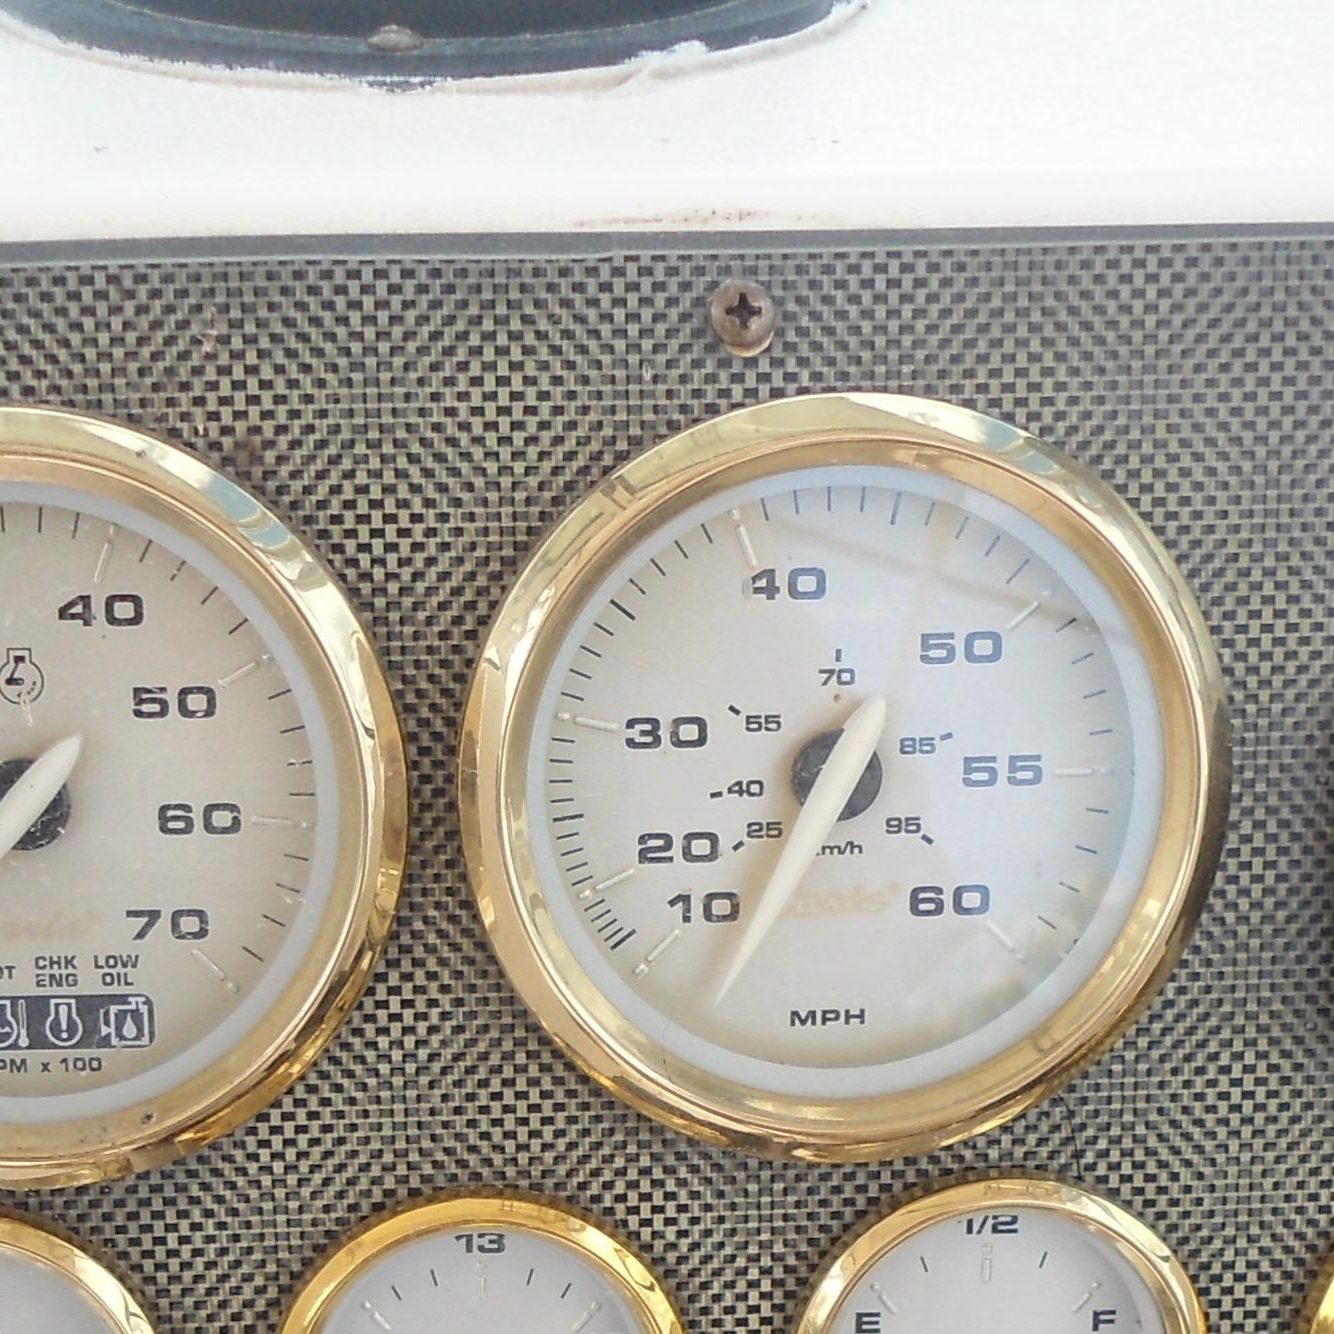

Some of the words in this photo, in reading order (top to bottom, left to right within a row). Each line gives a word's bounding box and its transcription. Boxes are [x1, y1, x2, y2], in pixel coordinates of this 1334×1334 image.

[743, 567, 827, 600] 40
[58, 593, 144, 627] 40
[919, 632, 1003, 665] 50
[819, 668, 856, 687] 70
[132, 685, 217, 720] 50
[624, 716, 708, 750] 30
[744, 714, 782, 733] 55
[899, 737, 937, 756] 85
[961, 754, 1043, 788] 55
[726, 779, 764, 798] 40
[157, 802, 242, 836] 60
[885, 816, 922, 835] 95
[745, 821, 783, 840] 25
[637, 830, 720, 865] 20
[814, 840, 864, 857] m/h
[667, 891, 740, 924] 10
[909, 884, 991, 917] 60
[125, 908, 210, 942] 70
[34, 955, 78, 970] CHK
[94, 954, 139, 969] LOW
[35, 973, 78, 988] ENG
[101, 972, 134, 987] OIL
[789, 1008, 866, 1027] MPH
[59, 1057, 102, 1073] 100
[957, 1214, 1019, 1235] 1/2
[454, 1233, 506, 1254] 13
[855, 1311, 882, 1334] E
[1092, 1309, 1116, 1332] F
